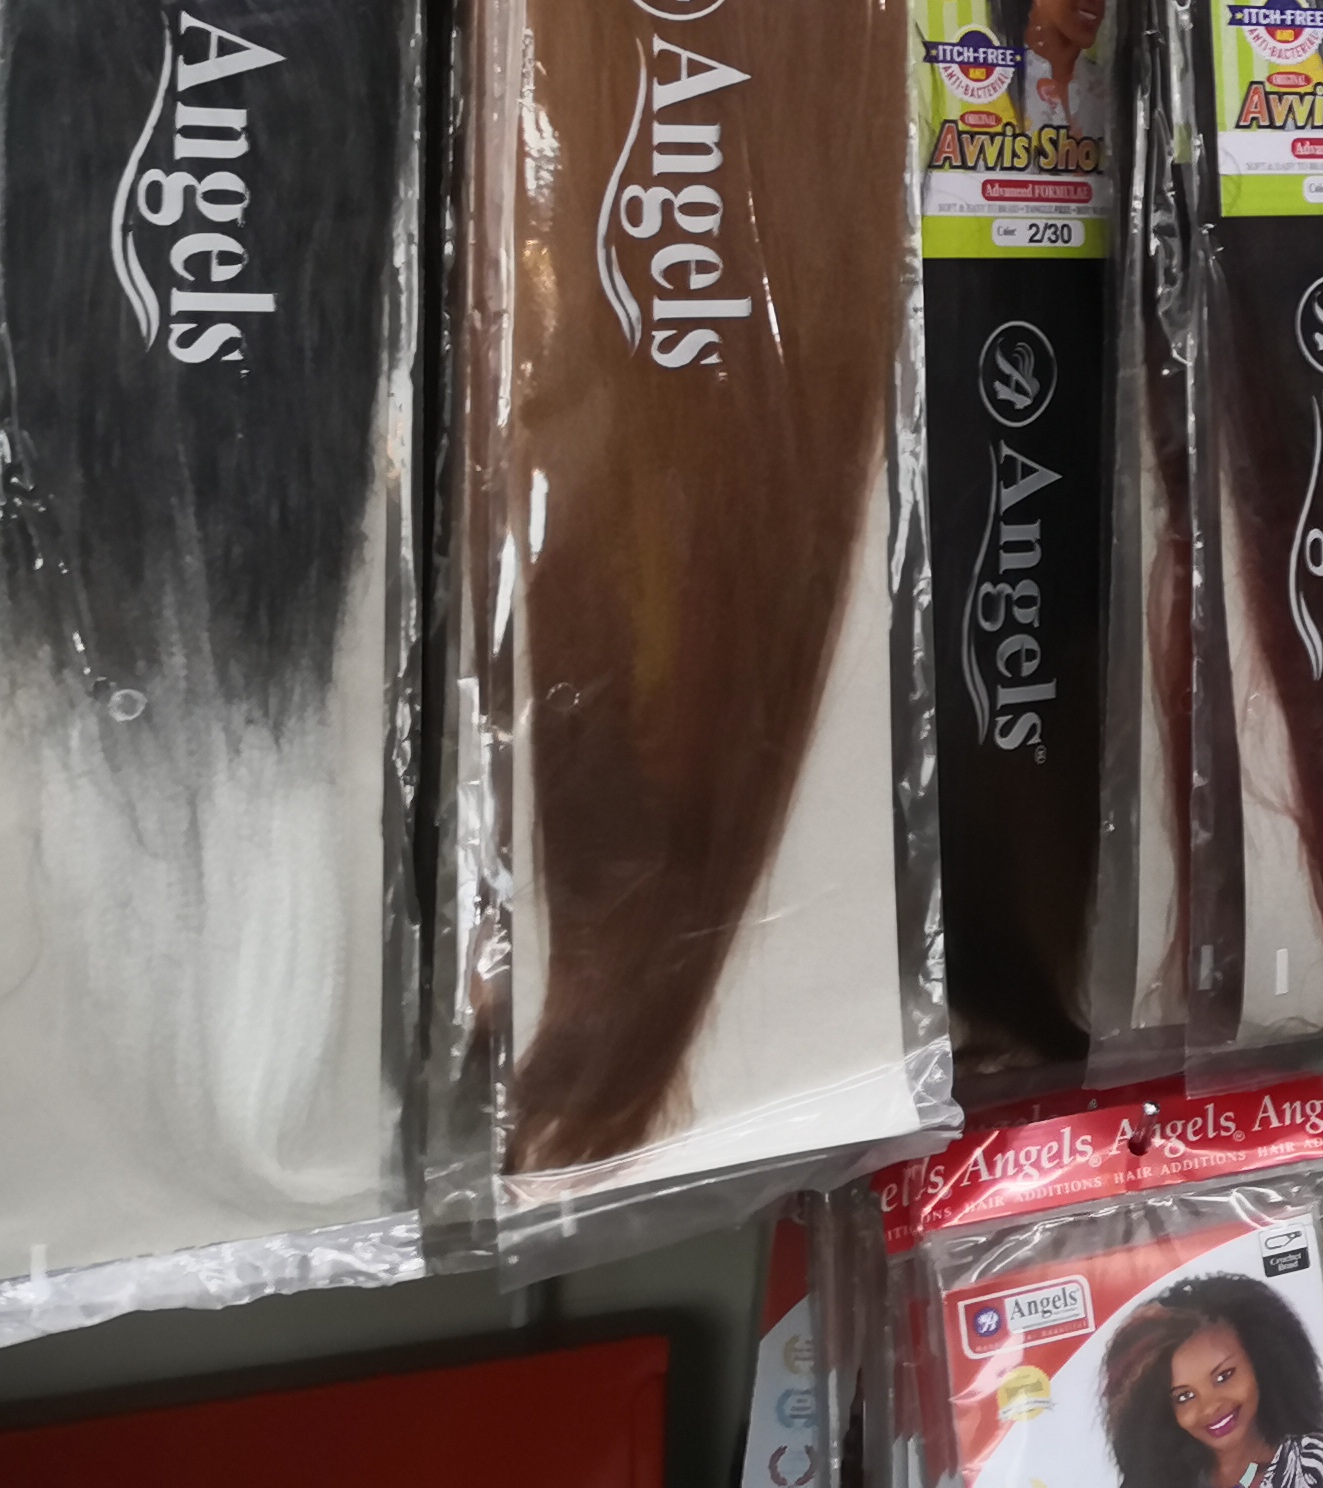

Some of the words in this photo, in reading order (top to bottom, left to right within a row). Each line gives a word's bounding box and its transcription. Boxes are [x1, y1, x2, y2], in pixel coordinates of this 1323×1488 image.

[938, 45, 1015, 65] ITCH-FREE
[928, 119, 1033, 173] Avvis
[137, 12, 288, 366] Angels
[619, 33, 754, 370] Angels
[1027, 222, 1073, 245] 2/30
[979, 440, 1065, 752] Angels
[961, 1128, 1095, 1188] Angels
[1113, 1166, 1154, 1186] HAIR
[1160, 1148, 1248, 1174] ADDITIONS
[1256, 1138, 1297, 1158] HAIR
[1009, 1286, 1080, 1322] Angels
